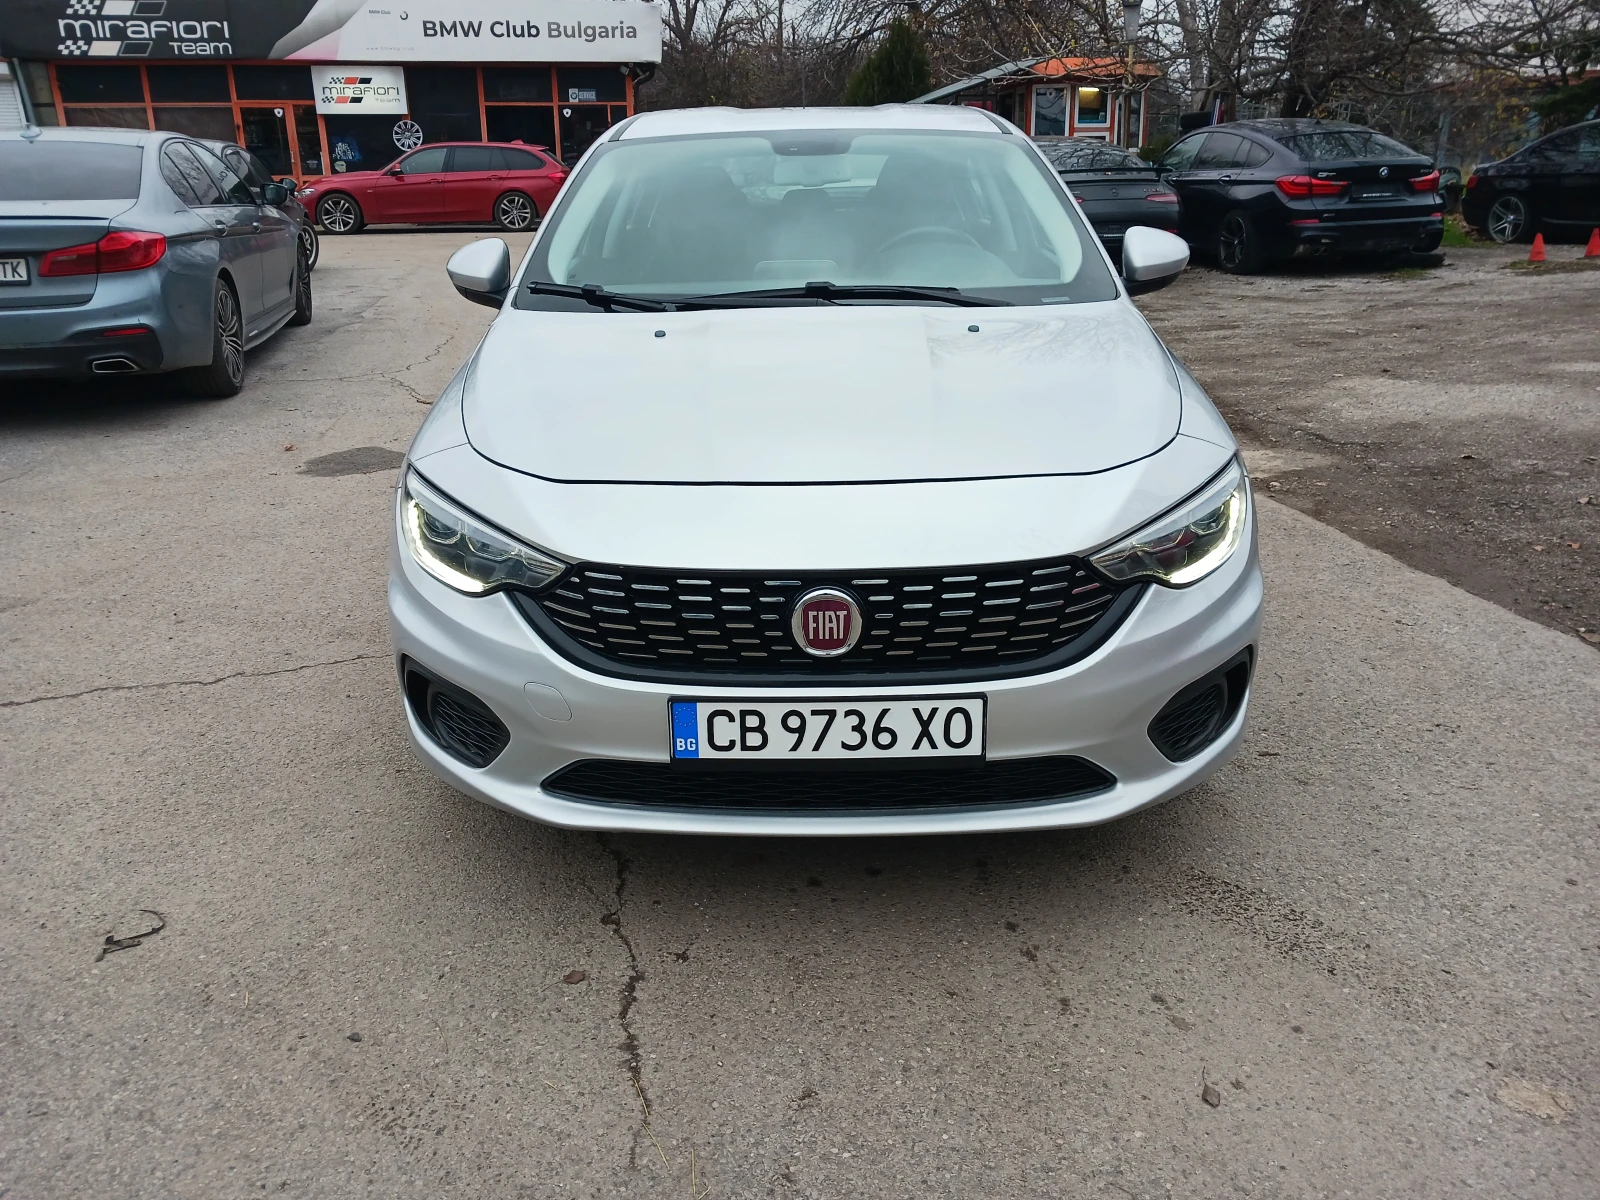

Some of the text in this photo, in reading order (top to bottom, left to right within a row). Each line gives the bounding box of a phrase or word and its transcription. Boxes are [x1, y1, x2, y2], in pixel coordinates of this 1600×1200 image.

[57, 18, 230, 39] mirafiori
[422, 20, 638, 43] BMW Club Bulgaria
[321, 86, 400, 96] mirafiori
[578, 91, 596, 99] SERVICE
[0, 261, 24, 279] TK
[808, 610, 848, 641] FIAT
[706, 706, 973, 752] CB 9736 XO
[676, 737, 697, 751] BG
